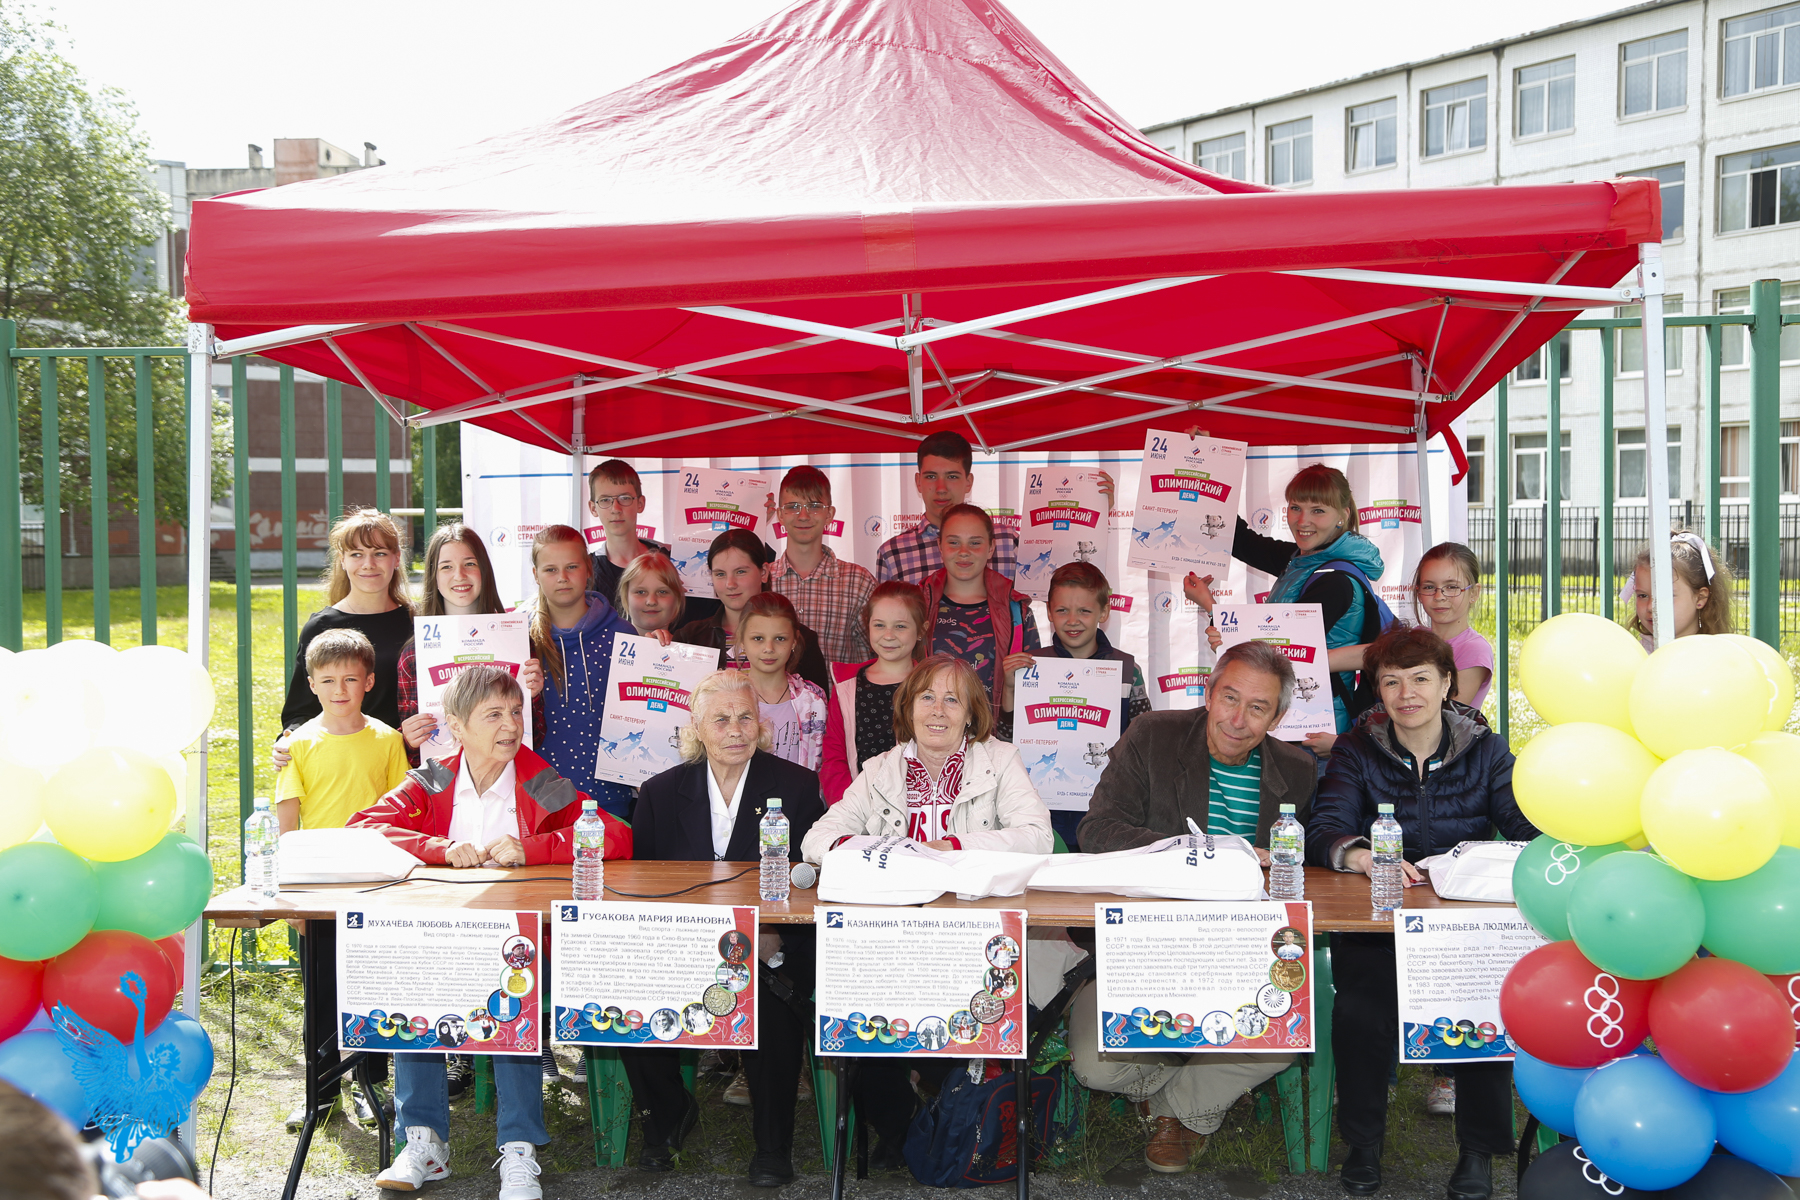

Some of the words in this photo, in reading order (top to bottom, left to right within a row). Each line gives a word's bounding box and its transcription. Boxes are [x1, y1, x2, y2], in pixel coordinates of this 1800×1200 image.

[1152, 437, 1168, 453] 24
[685, 473, 700, 487] 24
[1030, 474, 1043, 488] 24
[1158, 479, 1223, 496] ОЛИМПИЙСКИЙ
[1182, 492, 1196, 500] ДЕНЬ
[1036, 510, 1092, 523] ОЛИМПИЙСКИЙ
[1142, 505, 1179, 515] САНКТ-ПЕТЕРБУРГ
[1360, 507, 1420, 522] ОЛИМПИЙСКИЙ
[692, 511, 750, 526] ОЛИМПИЙСКИЙ
[1221, 611, 1238, 626] 24
[423, 624, 441, 640] 24
[619, 641, 636, 658] 24
[618, 658, 634, 666] ИЮНЯ
[1023, 665, 1039, 680] 24
[646, 678, 677, 687] ВСЕРОССИЙСКИЙ
[650, 701, 664, 709] ДЕНЬ
[610, 714, 647, 725] САНКТ-ПЕТЕРБУРГ
[1034, 706, 1102, 722] ОЛИМПИЙСКИЙ
[582, 912, 635, 922] ГУСАКОВА
[638, 914, 673, 923] МАРИЯ
[675, 916, 731, 925] ИВАНОВНА
[901, 920, 940, 928] ТАТЬЯНА
[942, 920, 1000, 929] ВАСИЛЬЕВНА
[1127, 914, 1173, 923] СЕМЕНЕЦ
[1176, 914, 1228, 922] ВЛАДИМИР
[1230, 913, 1282, 922] ИВАНОВИЧ
[368, 920, 414, 928] МУХАЧЁВА
[455, 921, 510, 930] АЛЕКСЕЕВНА
[1428, 923, 1480, 932] МУРАВЬЕВА
[1483, 922, 1529, 931] ЛЮДМИЛА
